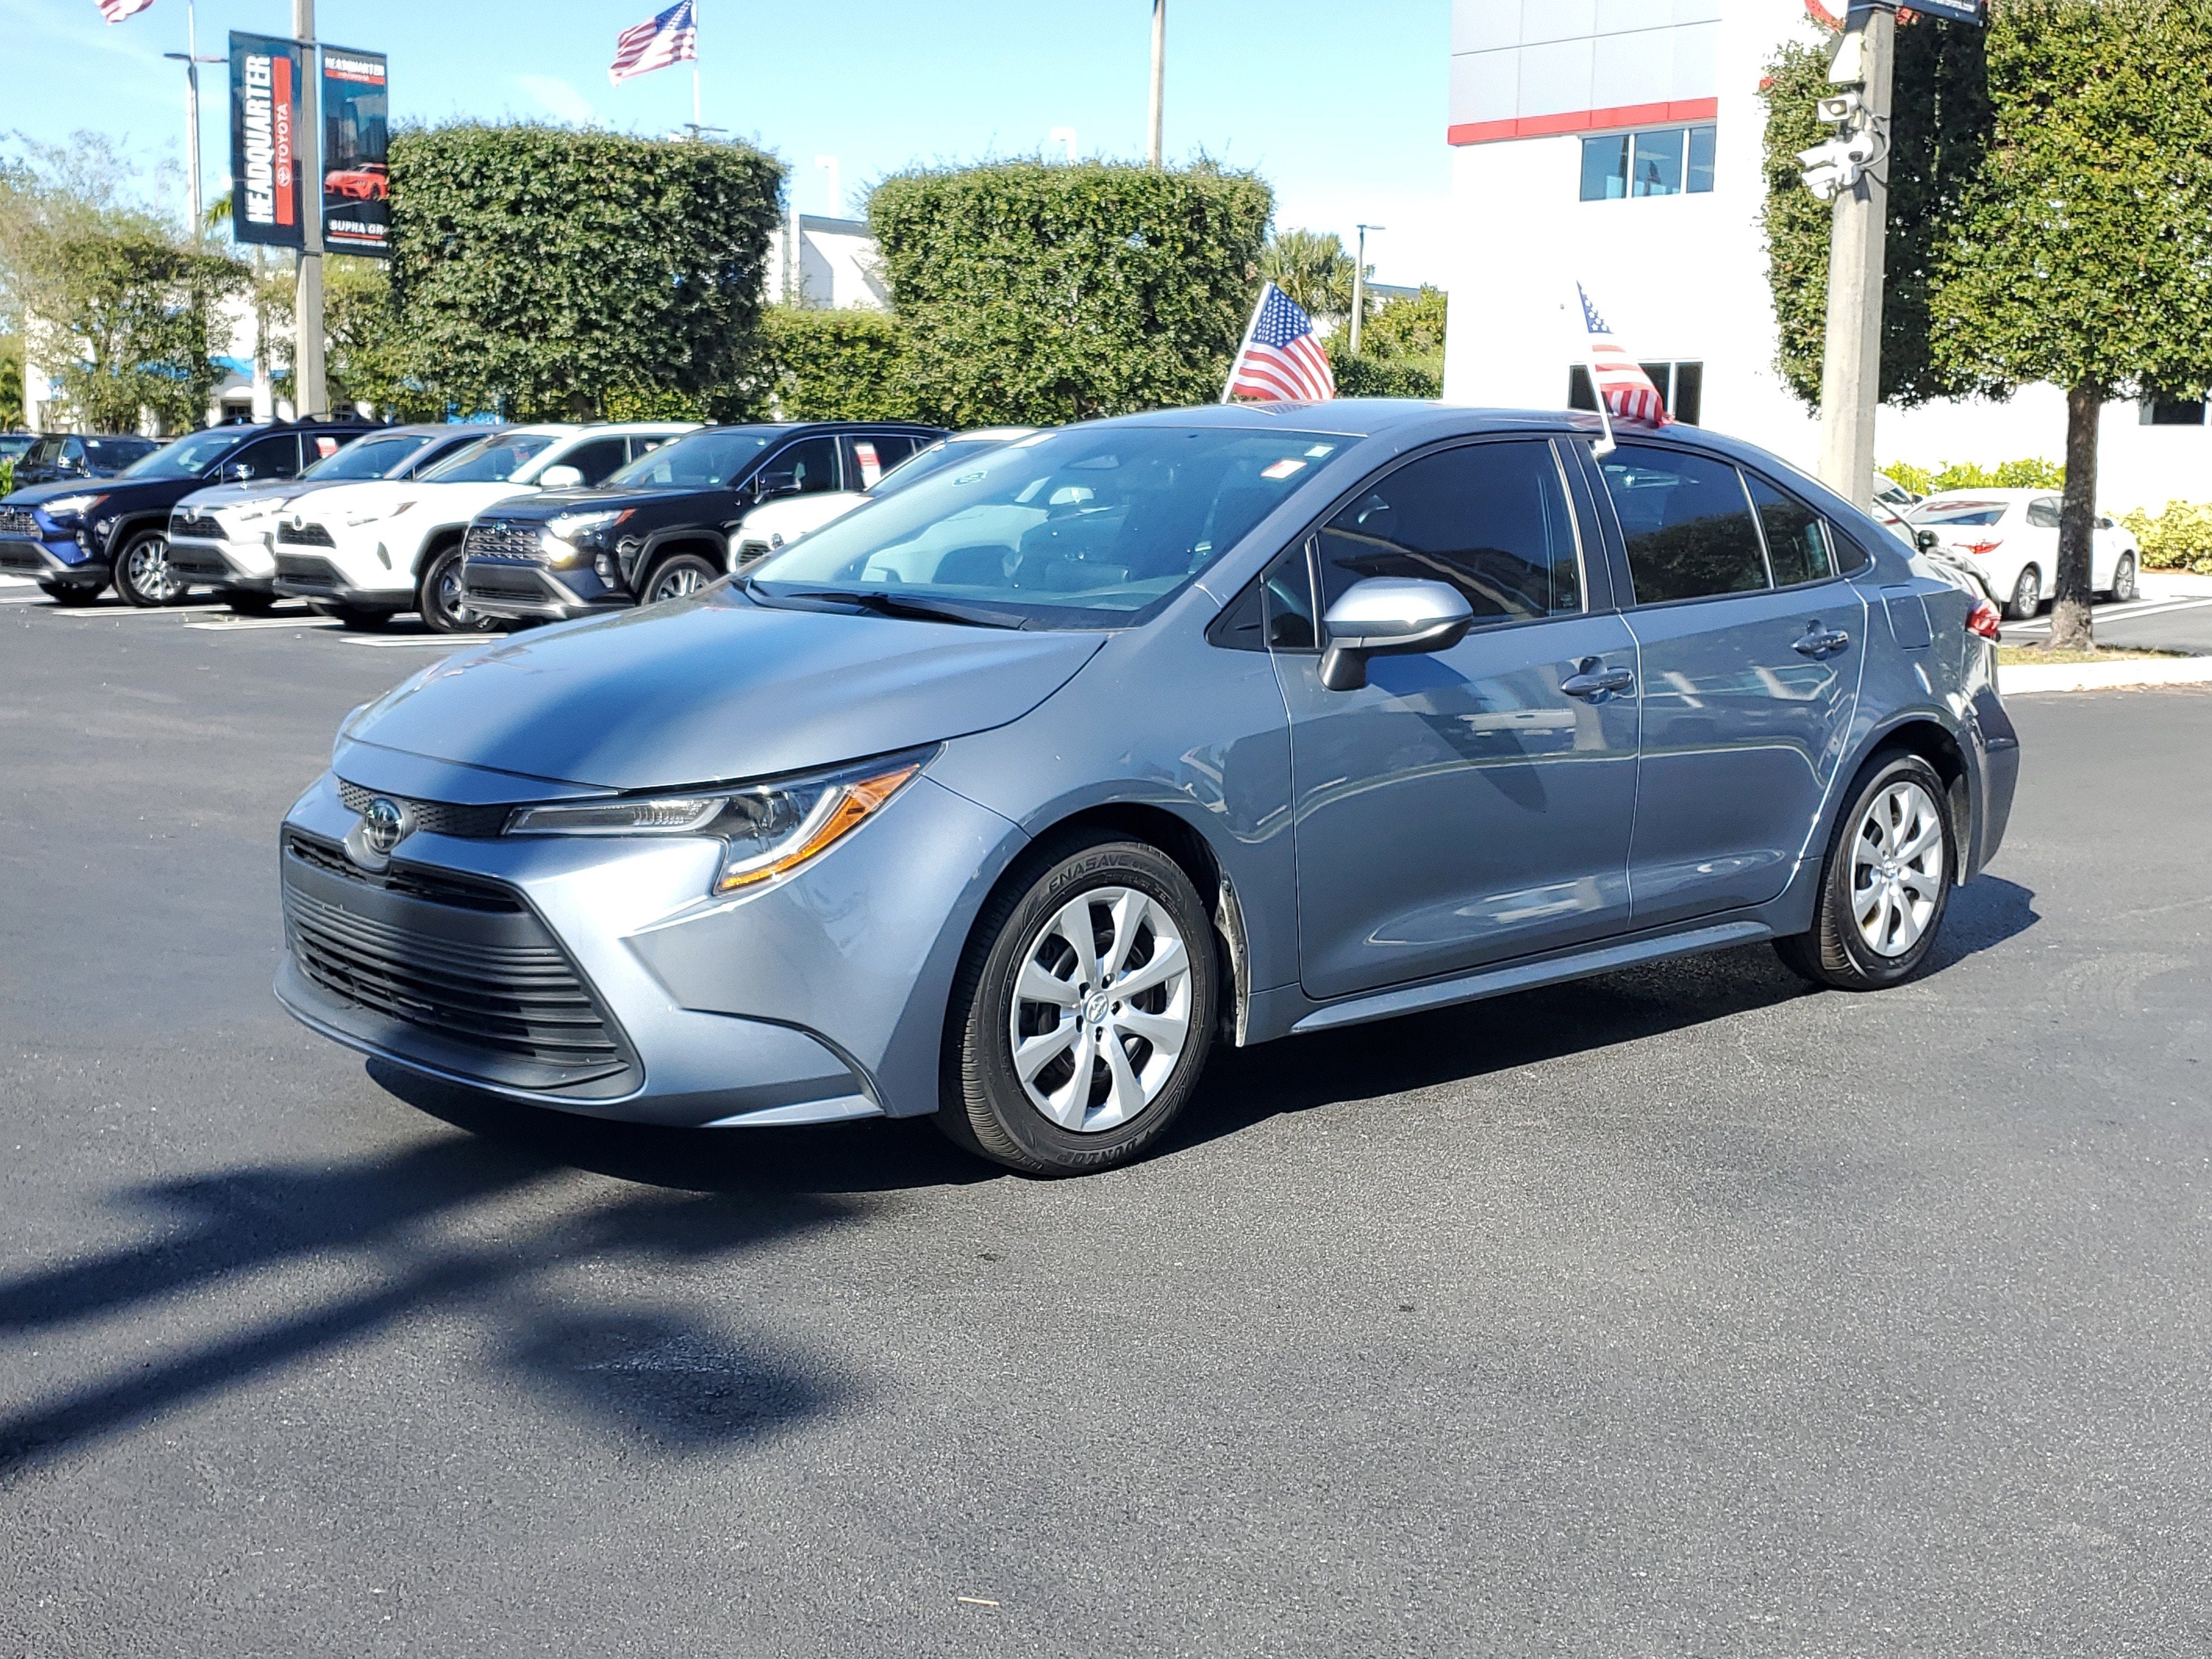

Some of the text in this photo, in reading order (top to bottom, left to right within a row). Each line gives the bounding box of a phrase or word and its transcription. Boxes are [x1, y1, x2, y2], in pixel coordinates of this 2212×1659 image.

[245, 55, 274, 223] HEADQUARTER
[277, 102, 289, 163] TOYOTA
[329, 219, 366, 234] SUPRA
[1048, 854, 1130, 893] ENASAVE
